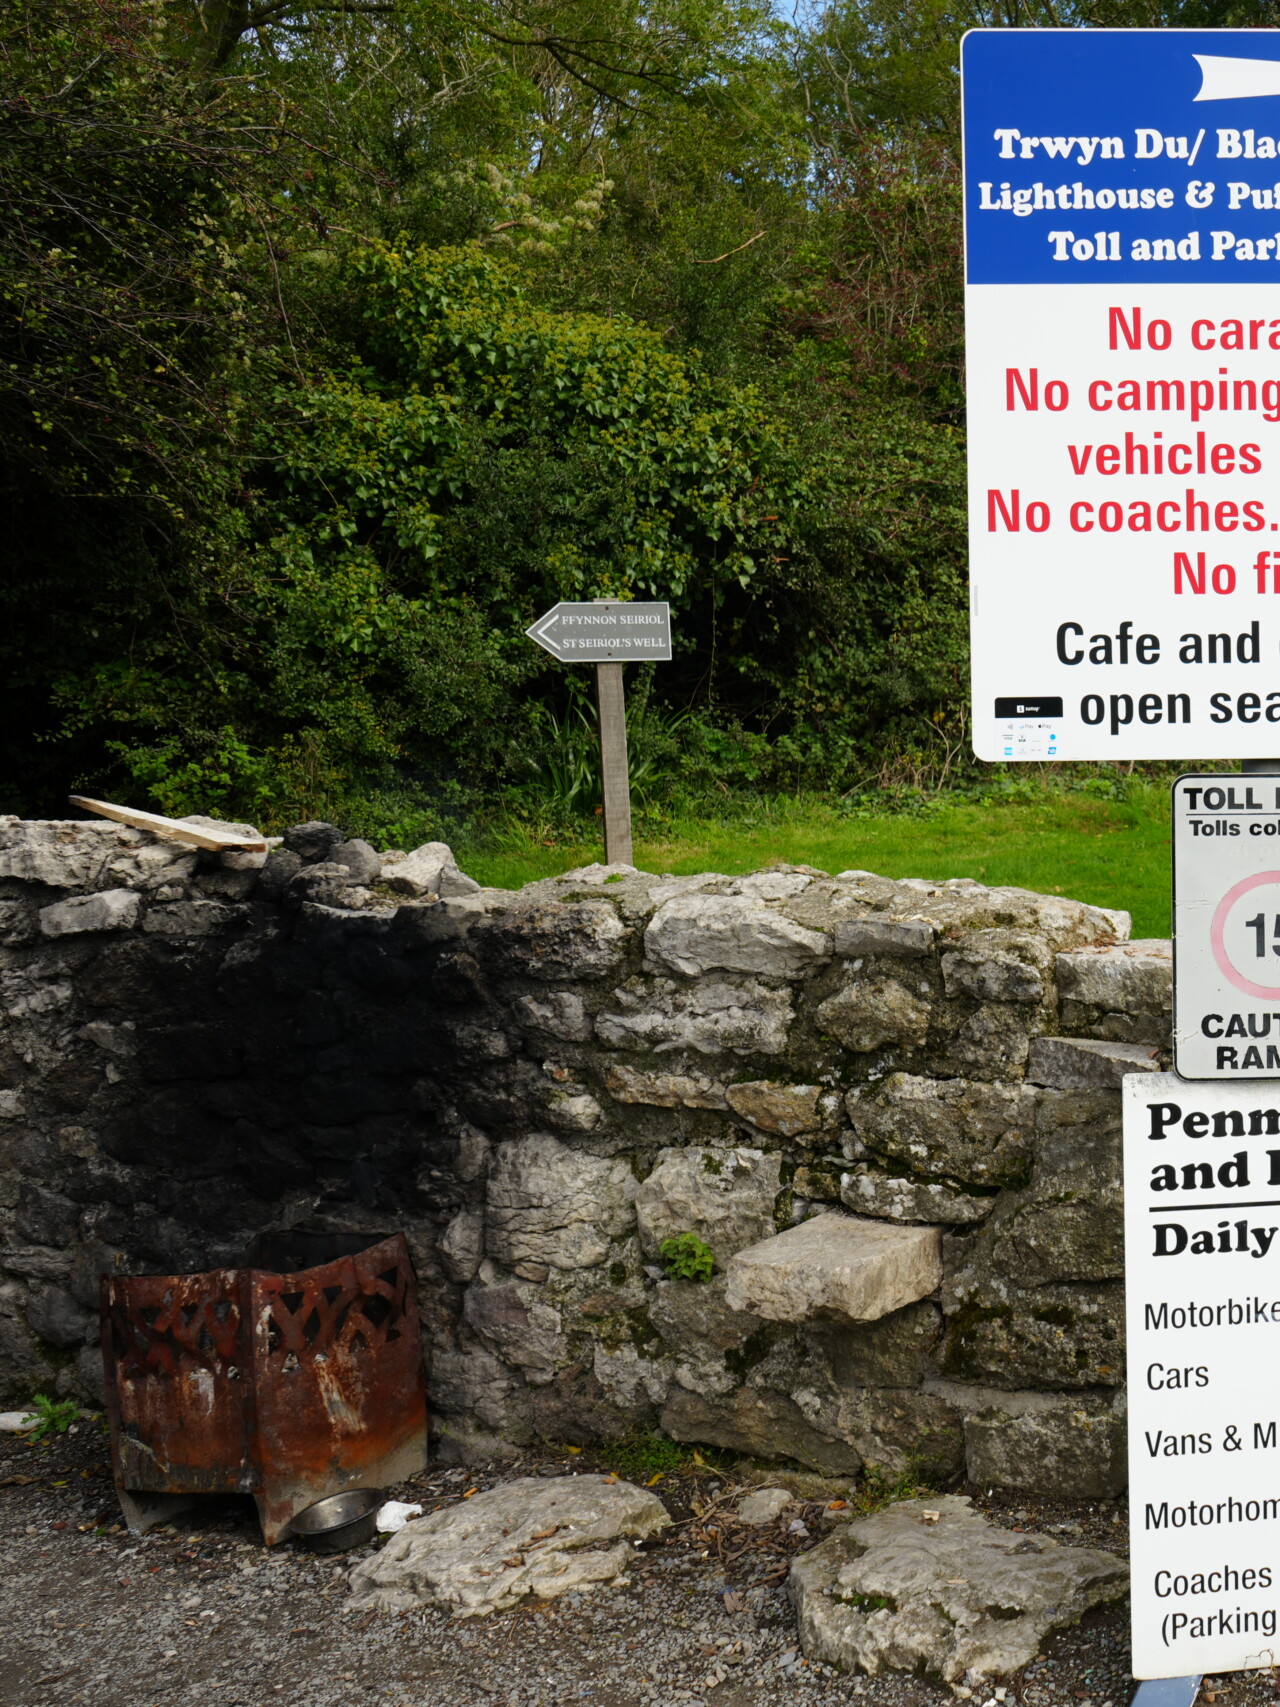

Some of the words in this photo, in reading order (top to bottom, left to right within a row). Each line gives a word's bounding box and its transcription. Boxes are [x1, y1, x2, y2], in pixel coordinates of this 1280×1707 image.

[994, 129, 1125, 165] Trwyn
[1135, 129, 1205, 166] Du/
[979, 182, 1174, 216] Lighthouse
[1185, 181, 1215, 208] &
[1048, 231, 1121, 261] Toll
[1131, 231, 1201, 260] and
[1109, 307, 1171, 350] No
[1006, 368, 1068, 411] No
[1068, 432, 1261, 475] vehicles
[988, 490, 1050, 532] No
[1070, 489, 1278, 532] coaches.
[1174, 552, 1236, 594] No
[562, 616, 616, 624] FFYNNON
[620, 615, 664, 624] SEIRIOL
[563, 640, 576, 648] ST
[579, 639, 631, 647] SEIRIOL'S
[634, 638, 666, 647] WELL
[1057, 622, 1160, 665] Cafe
[1179, 621, 1259, 663] and
[1081, 694, 1190, 735] open
[1183, 787, 1262, 810] TOLL
[1189, 820, 1240, 836] Tolls
[1150, 1151, 1250, 1191] and
[1153, 1220, 1278, 1258] Daily
[1148, 1363, 1208, 1390] Cars
[1145, 1431, 1211, 1457] Vans
[1223, 1425, 1241, 1451] &
[1155, 1566, 1271, 1597] Coaches
[1162, 1607, 1276, 1646] (Parking
